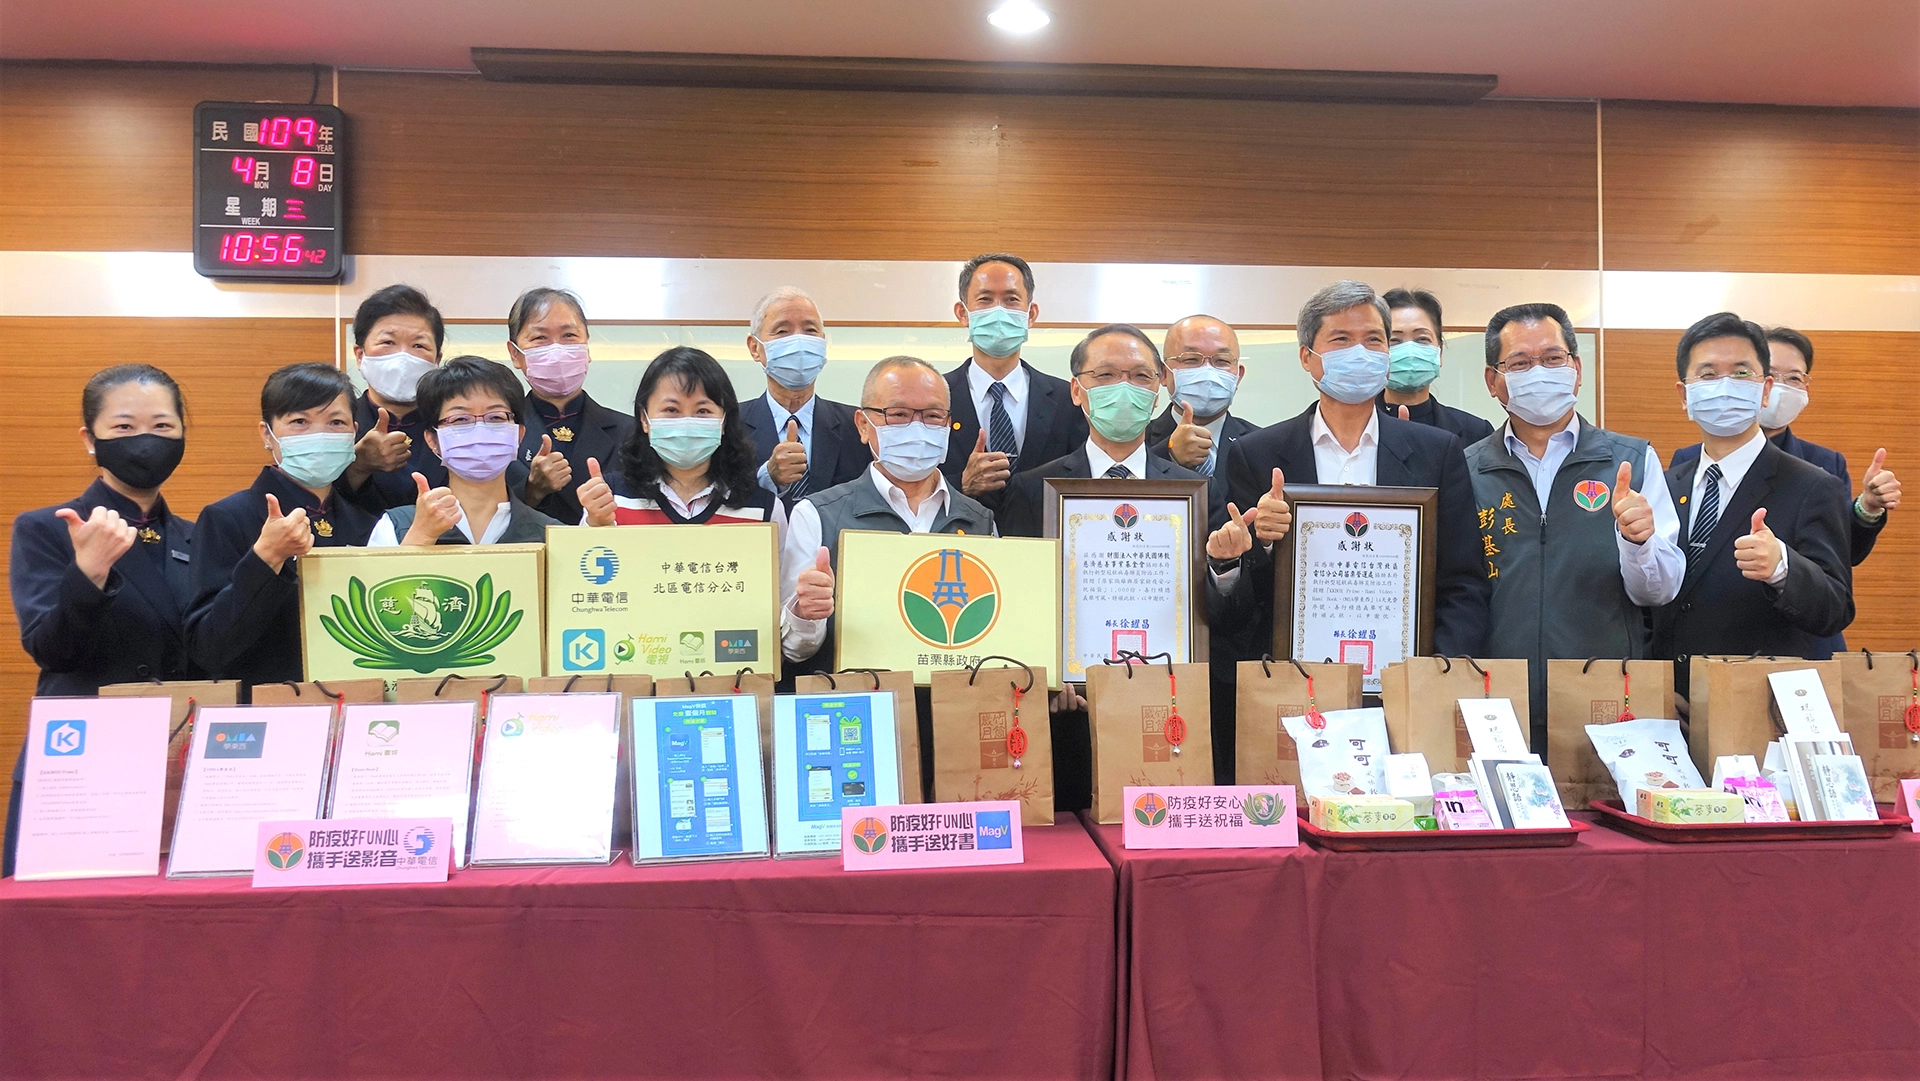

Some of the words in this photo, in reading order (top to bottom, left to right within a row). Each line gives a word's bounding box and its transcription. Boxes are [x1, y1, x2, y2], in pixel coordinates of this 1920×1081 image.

[212, 121, 259, 141] 民國
[257, 118, 316, 147] 109
[318, 125, 333, 143] 年
[316, 144, 333, 152] YEAR
[232, 156, 255, 184] 4
[255, 161, 270, 181] 月
[292, 156, 316, 187] 8
[319, 164, 333, 182] 日
[254, 181, 269, 189] MON
[318, 184, 333, 192] DAY
[225, 196, 277, 217] 星期
[283, 198, 307, 219] 三
[241, 217, 260, 225] WEEK
[220, 232, 305, 264] 10:56
[305, 249, 327, 264] 42
[1499, 492, 1518, 535] 處長
[1107, 531, 1144, 542] 感謝狀
[1477, 507, 1501, 579] 彭基山
[1338, 540, 1374, 552] 感謝狀
[661, 561, 739, 575] 中華電信台灣
[653, 581, 745, 594] 北區電信分公司
[572, 592, 628, 604] 中華電信
[379, 597, 401, 615] 慈
[442, 596, 467, 612] 濟
[572, 606, 603, 614] Chunghwa
[637, 634, 668, 643] Hami
[641, 645, 672, 654] Video
[646, 655, 669, 665] 電視
[917, 654, 982, 667] 苗栗縣政府
[1349, 739, 1371, 766] 可可
[1655, 741, 1678, 765] 可可
[1505, 771, 1522, 802] 靜思語
[1167, 795, 1243, 810] 防疫好安心
[890, 812, 974, 832] 防疫好FUN心
[1168, 813, 1243, 828] 攜手送祝福
[308, 829, 399, 848] 防疫好FUN心
[979, 825, 1009, 838] MagV
[891, 833, 975, 853] 攜手送好書
[307, 850, 397, 869] 攜手送影音
[397, 856, 437, 865] 中華電信
